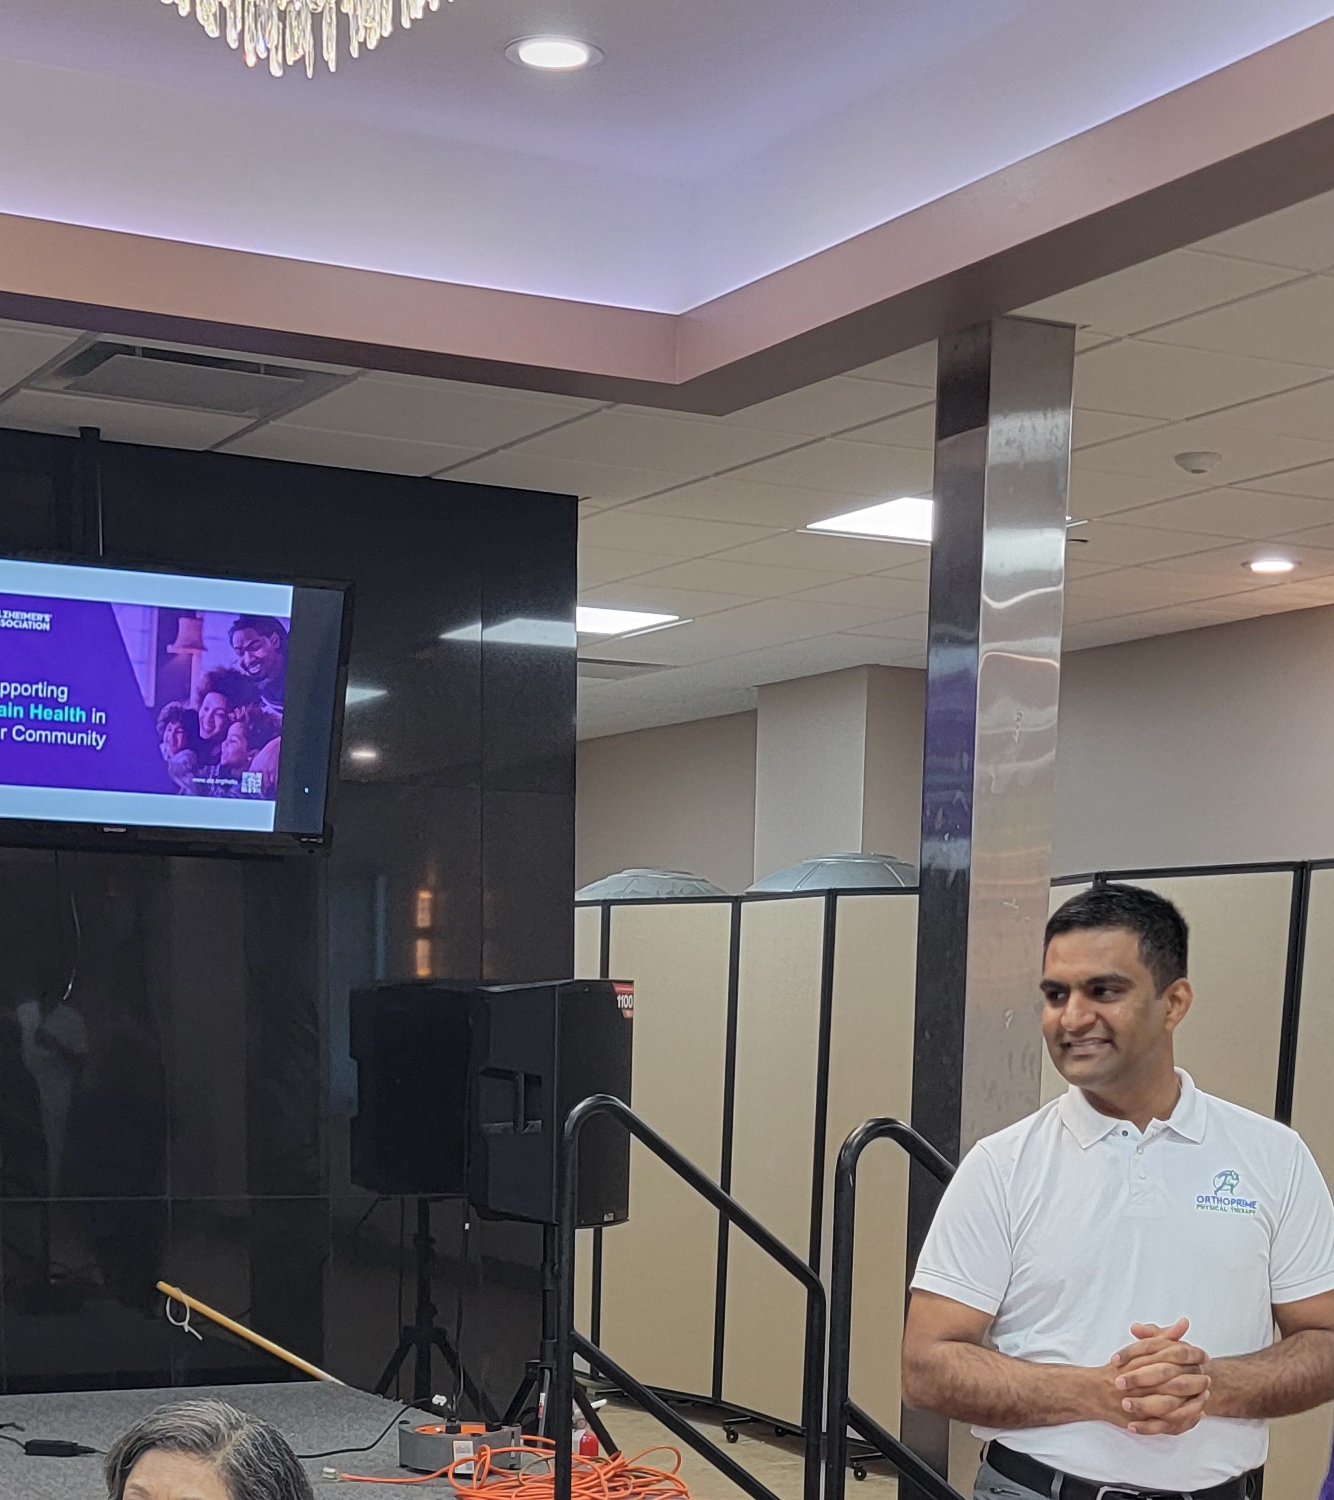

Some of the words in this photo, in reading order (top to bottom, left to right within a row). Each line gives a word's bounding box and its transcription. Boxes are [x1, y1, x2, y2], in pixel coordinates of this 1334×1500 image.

[29, 703, 87, 724] Health
[91, 707, 106, 725] in
[12, 725, 107, 751] Community
[616, 994, 634, 1009] 1100
